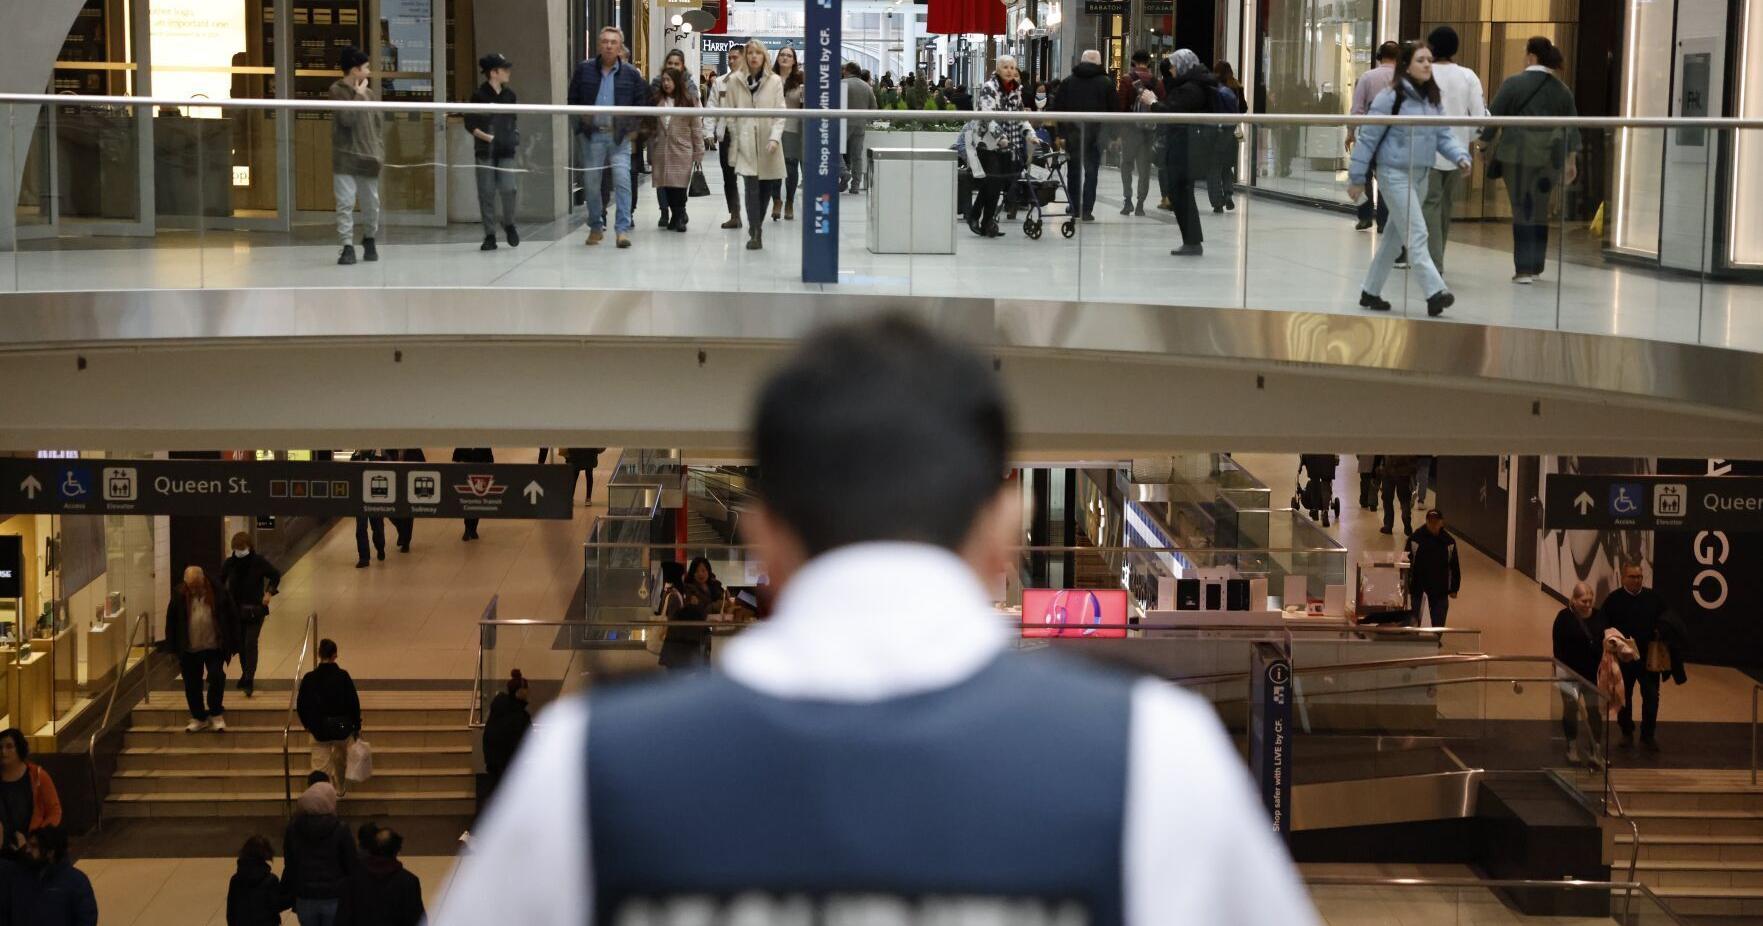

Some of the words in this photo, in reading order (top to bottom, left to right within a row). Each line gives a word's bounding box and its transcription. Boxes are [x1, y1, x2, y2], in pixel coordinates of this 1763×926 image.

[702, 39, 729, 52] HARRY
[820, 27, 830, 46] CF.
[820, 48, 832, 61] by
[820, 64, 829, 89] LIVE
[819, 118, 829, 145] safer
[819, 147, 830, 175] Shop
[154, 476, 222, 495] Queen
[228, 477, 252, 494] St.
[411, 505, 437, 515] Subway
[1655, 518, 1683, 526] Elevator
[1275, 734, 1284, 745] by
[1274, 746, 1282, 765] LIVE
[1273, 786, 1281, 808] safer
[1272, 808, 1282, 832] Shop
